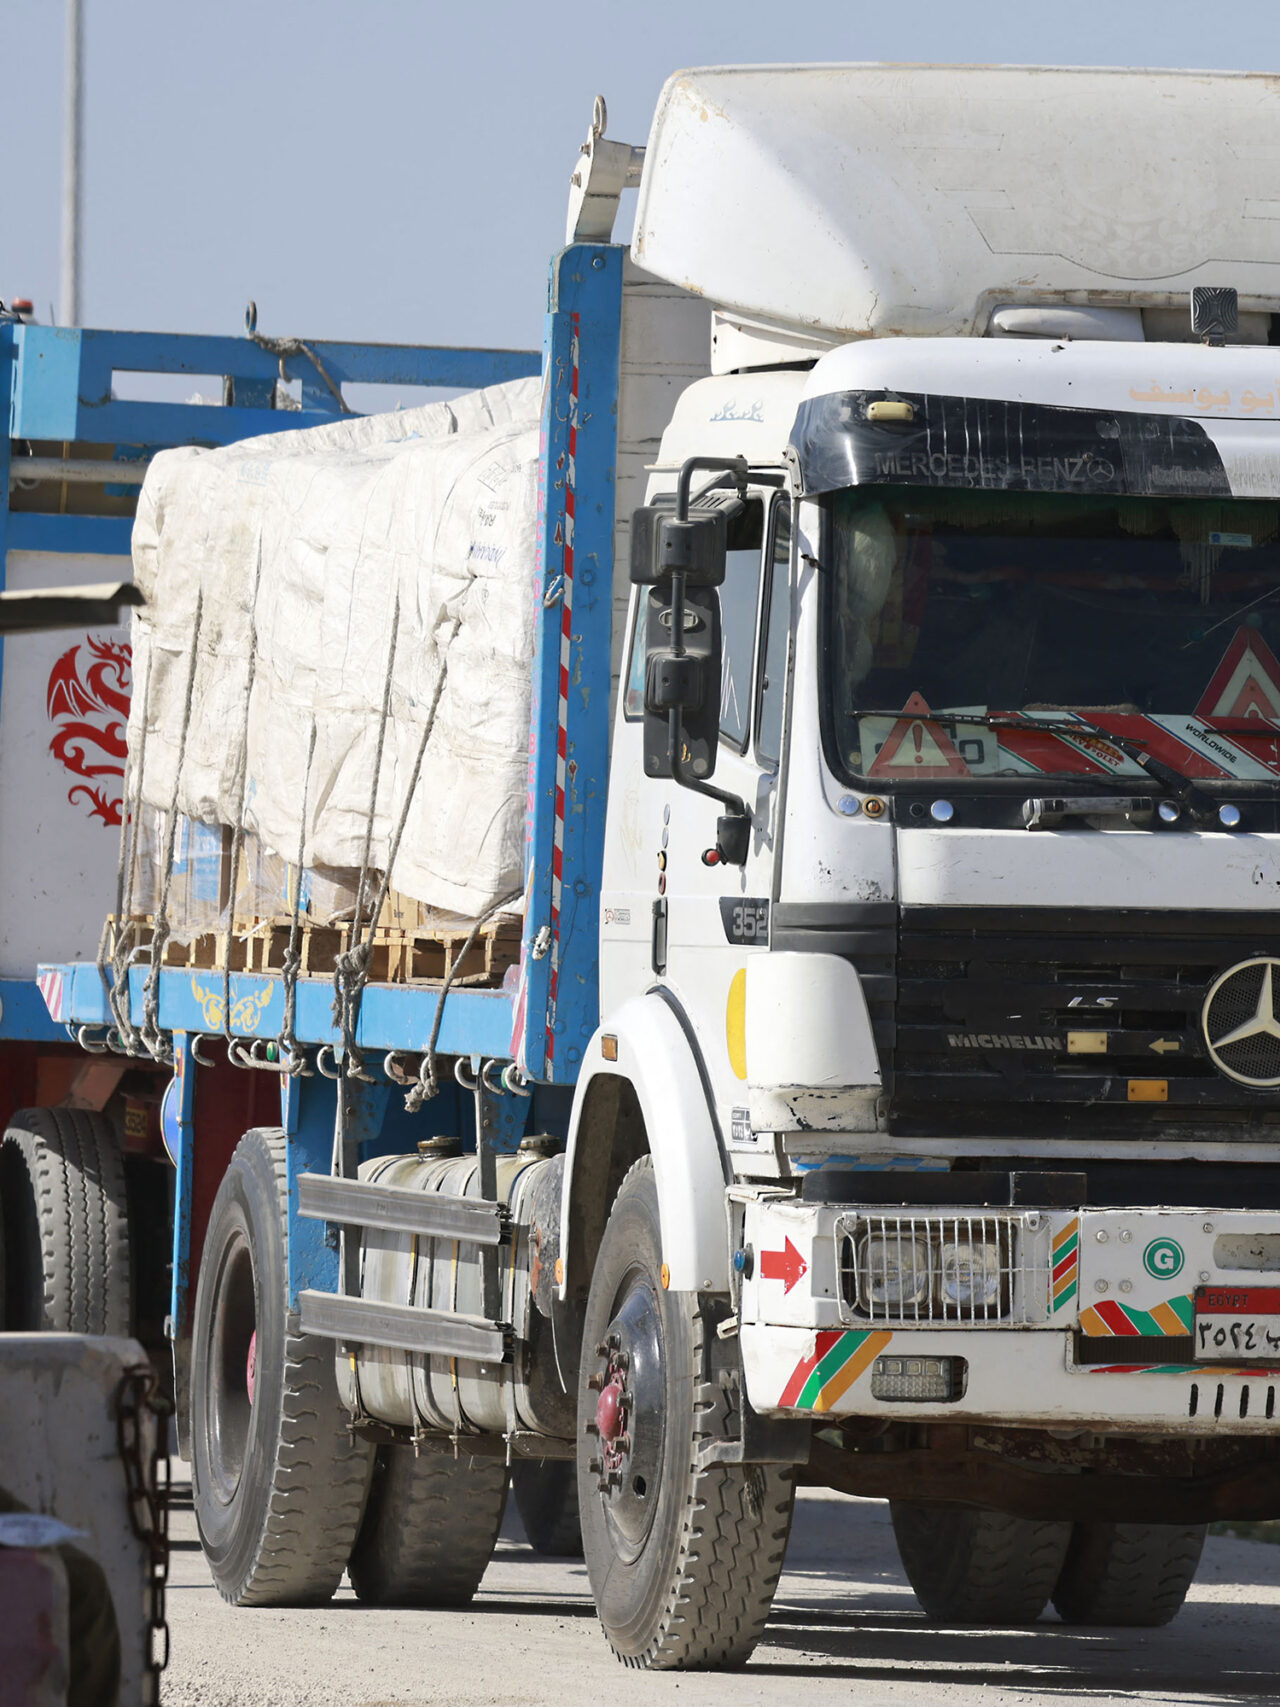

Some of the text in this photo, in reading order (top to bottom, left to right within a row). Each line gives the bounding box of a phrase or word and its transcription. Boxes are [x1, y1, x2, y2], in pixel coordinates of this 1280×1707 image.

[875, 452, 1086, 482] MERCEDES BENZ
[524, 733, 538, 842] BENZ
[1067, 996, 1120, 1009] LS
[947, 1033, 1064, 1051] MICHELIN
[1153, 1247, 1175, 1271] G
[1208, 1293, 1249, 1308] EGYPT
